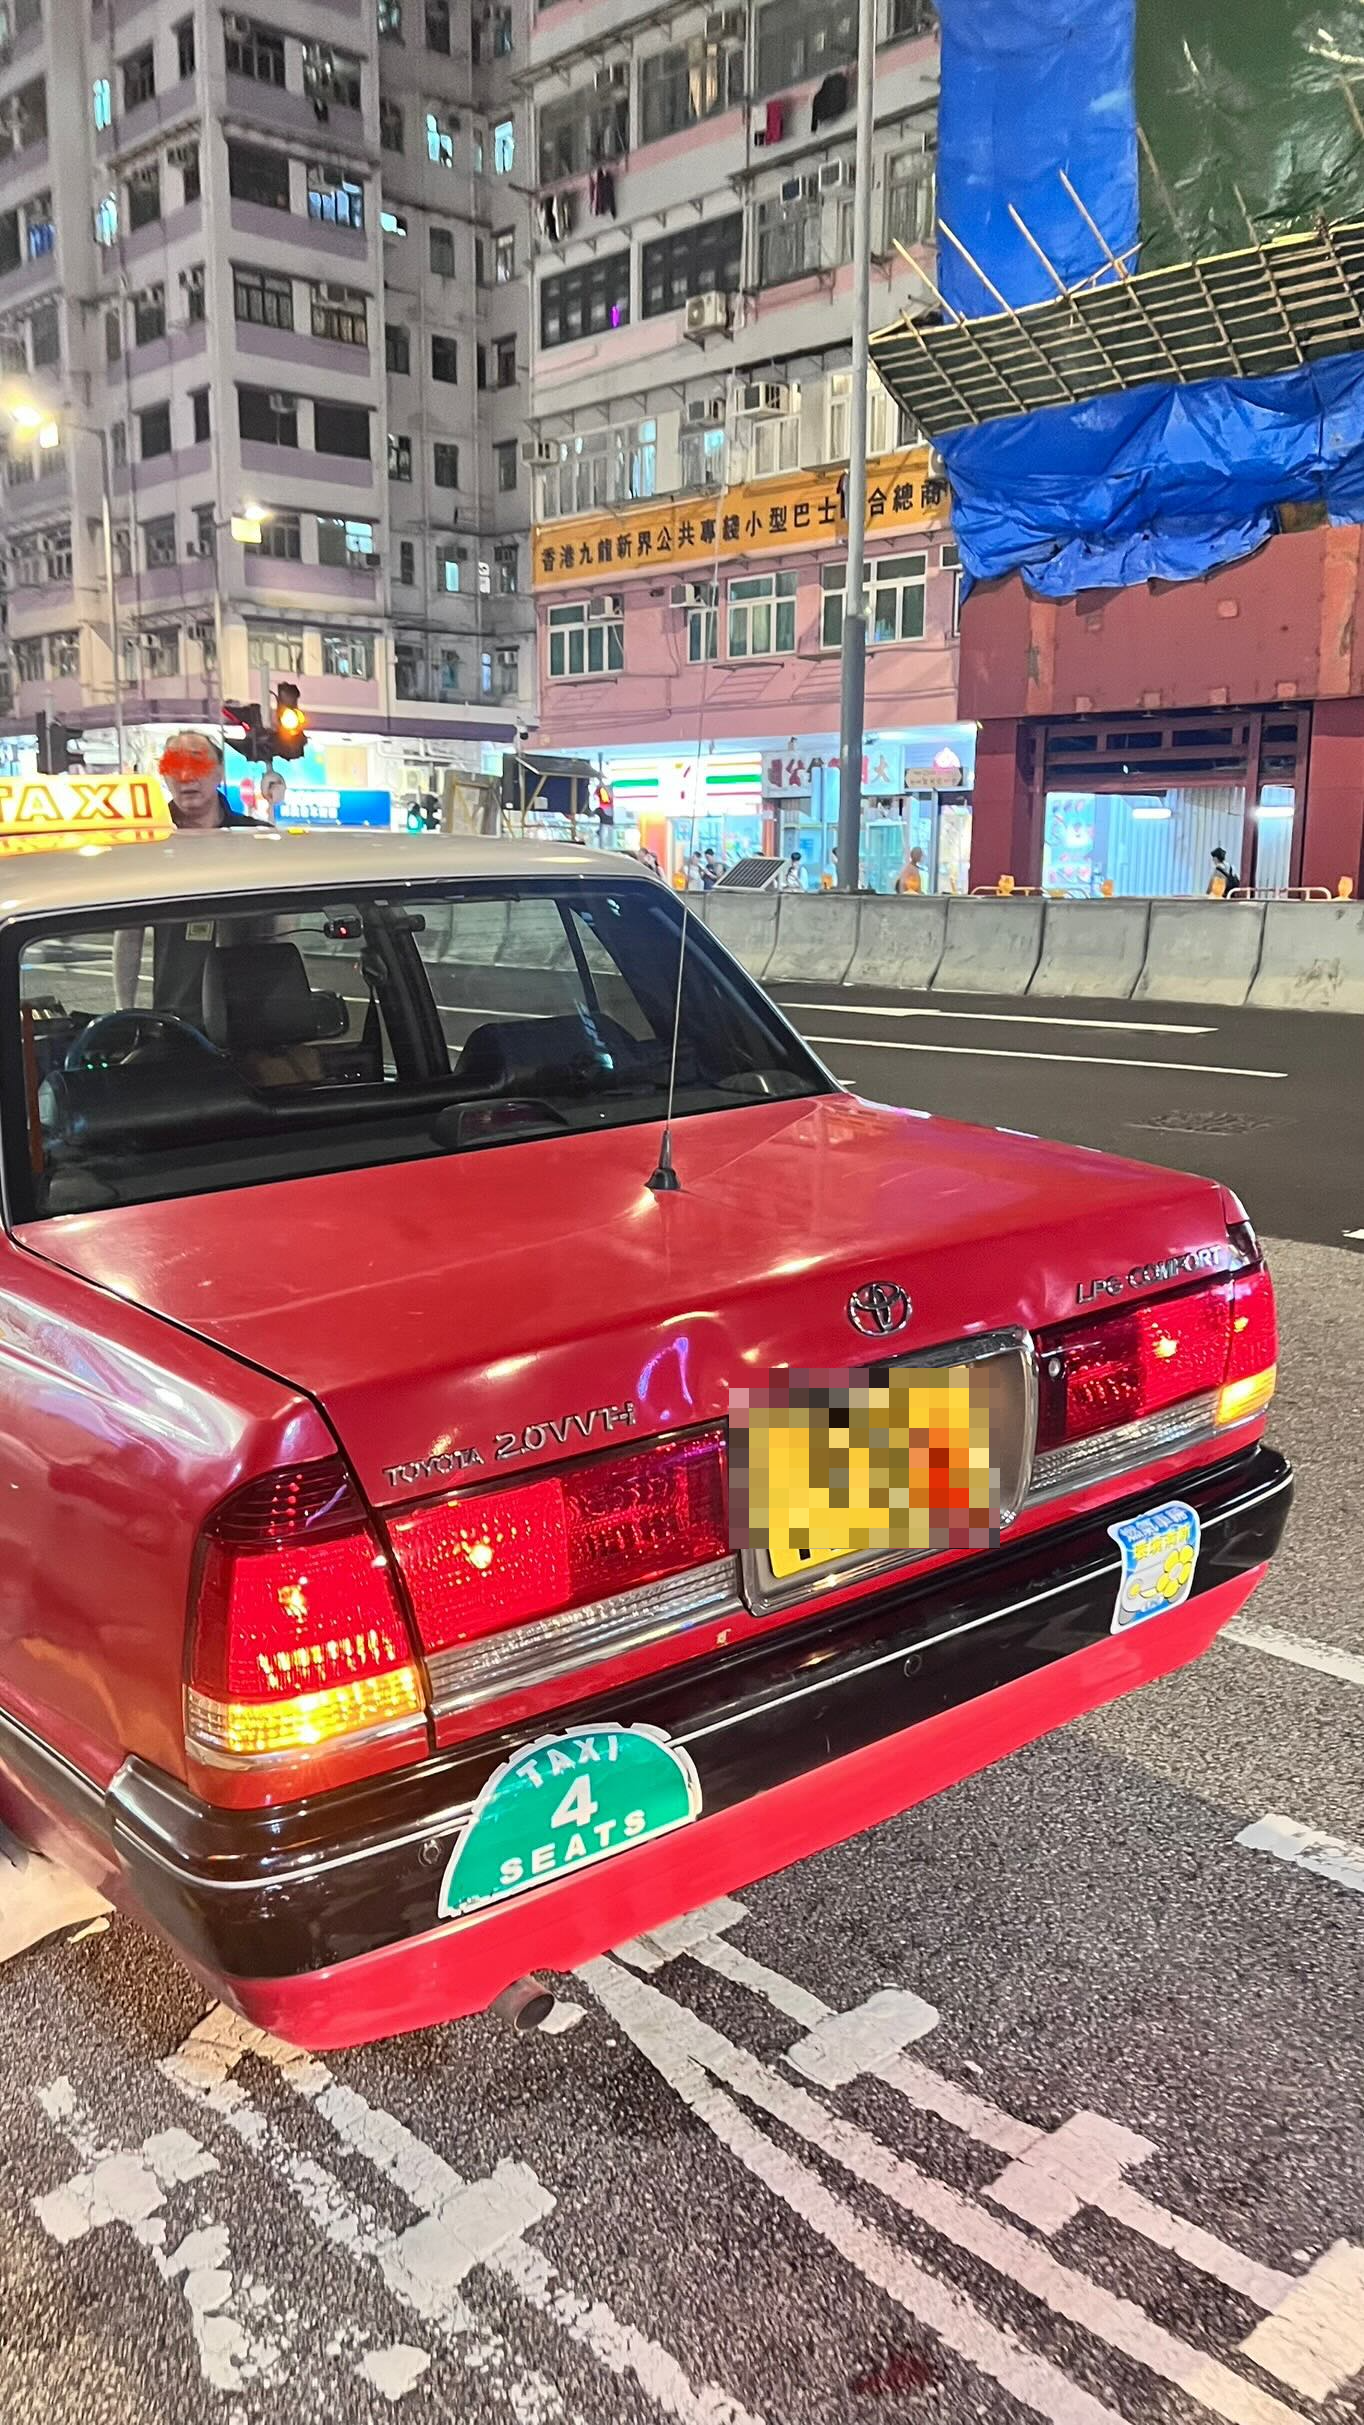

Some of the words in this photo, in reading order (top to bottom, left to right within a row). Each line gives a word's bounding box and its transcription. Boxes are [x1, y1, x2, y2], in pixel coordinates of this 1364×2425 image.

[1126, 1246, 1222, 1289] COMFORT
[382, 1447, 485, 1488] TOYOTA
[516, 1735, 618, 1788] TAXI
[550, 1773, 598, 1829] 4
[499, 1809, 646, 1885] SEATS
